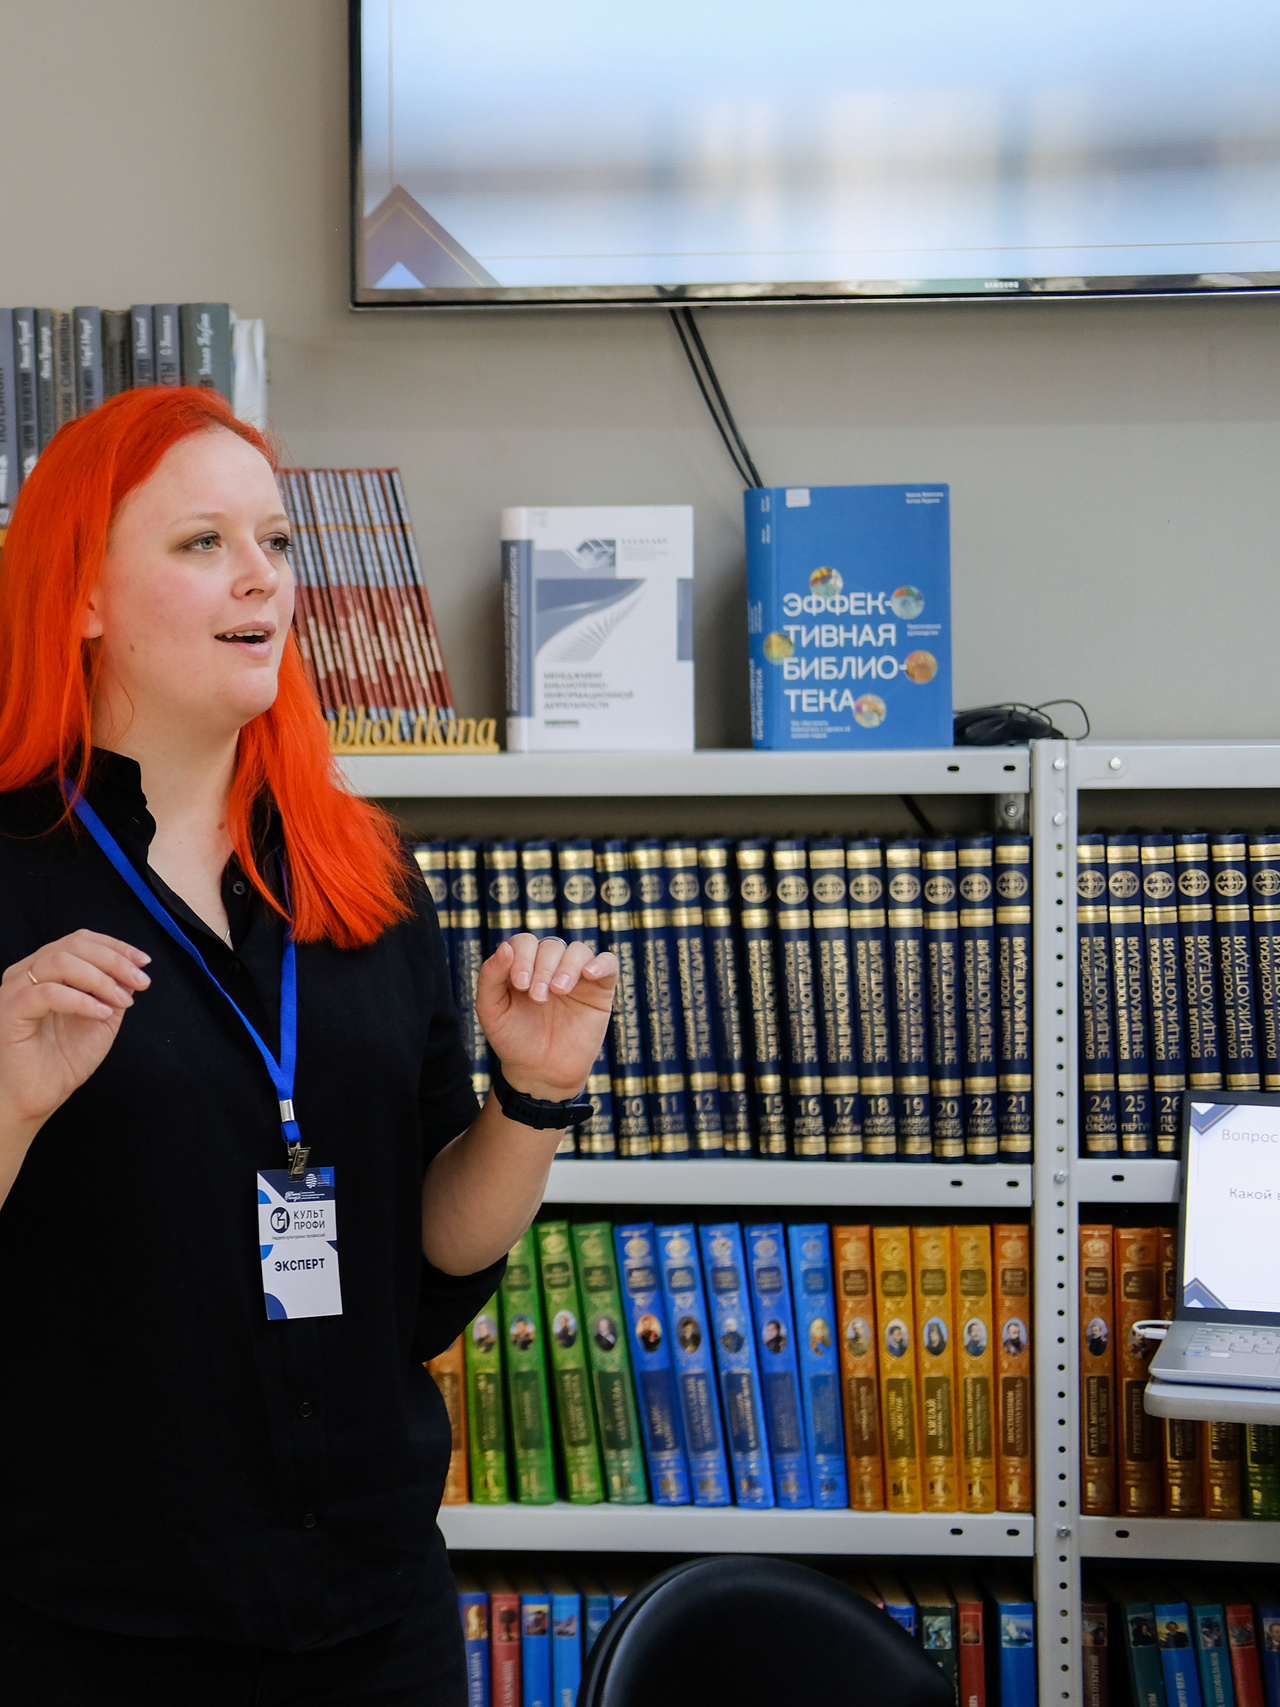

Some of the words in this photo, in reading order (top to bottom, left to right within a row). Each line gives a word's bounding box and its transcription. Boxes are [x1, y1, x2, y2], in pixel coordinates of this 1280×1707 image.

[783, 592, 892, 617] ЭФФЕК-
[783, 623, 896, 648] ТИВНАЯ
[783, 655, 907, 680] БИБЛИО-
[784, 688, 855, 713] ТЕКА
[643, 940, 658, 1010] РОССИЙСКАЯ
[677, 938, 691, 1009] РОССИЙСКАЯ
[748, 940, 762, 1010] РОССИЙСКАЯ
[785, 941, 798, 1012] РОССИЙСКАЯ
[820, 940, 834, 1011] РОССИЙСКАЯ
[856, 940, 870, 1011] РОССИЙСКАЯ
[894, 939, 907, 1011] РОССИЙСКАЯ
[929, 942, 940, 1013] РОССИЙСКАЯ
[963, 939, 976, 1010] РОССИЙСКАЯ
[1000, 936, 1011, 1008] РОССИЙСКАЯ
[1080, 936, 1093, 1007] РОССИЙСКАЯ
[1113, 936, 1128, 1007] РОССИЙСКАЯ
[1149, 938, 1164, 1008] РОССИЙСКАЯ
[1183, 935, 1199, 1006] РОССИЙСКАЯ
[1220, 936, 1235, 1006] РОССИЙСКАЯ
[1256, 936, 1273, 1006] РОССИЙСКАЯ
[619, 941, 642, 1064] ЭНЦИКЛОПЕДИЯ
[655, 939, 675, 1060] ЭНЦИКЛОПЕДИЯ
[690, 937, 711, 1059] ЭНЦИКЛОПЕДИЯ
[796, 940, 818, 1063] ЭНЦИКЛОПЕДИЯ
[832, 939, 853, 1063] ЭНЦИКЛОПЕДИЯ
[868, 940, 890, 1063] ЭНЦИКЛОПЕДИЯ
[906, 939, 925, 1062] ЭНЦИКЛОПЕДИЯ
[940, 941, 958, 1065] ЭНЦИКЛОПЕДИЯ
[976, 939, 994, 1063] ЭНЦИКЛОПЕДИЯ
[1012, 936, 1029, 1060] ЭНЦИКЛОПЕДИЯ
[1093, 935, 1112, 1060] ЭНЦИКЛОПЕДИЯ
[1126, 936, 1145, 1060] ЭНЦИКЛОПЕДИЯ
[1161, 937, 1181, 1060] ЭНЦИКЛОПЕДИЯ
[1196, 935, 1217, 1058] ЭНЦИКЛОПЕДИЯ
[1233, 935, 1255, 1059] ЭНЦИКЛОПЕДИЯ
[648, 1012, 661, 1062] БОЛЬШАЯ
[681, 1011, 695, 1060] БОЛЬШАЯ
[753, 1012, 768, 1062] БОЛЬШАЯ
[789, 1013, 802, 1064] БОЛЬШАЯ
[825, 1012, 837, 1063] БОЛЬШАЯ
[860, 1013, 874, 1064] БОЛЬШАЯ
[897, 1013, 909, 1064] БОЛЬШАЯ
[930, 1014, 942, 1065] БОЛЬШАЯ
[965, 1012, 978, 1063] БОЛЬШАЯ
[1001, 1009, 1012, 1060] БОЛЬШАЯ
[1083, 1009, 1096, 1060] БОЛЬШАЯ
[1117, 1009, 1130, 1060] БОЛЬШАЯ
[1152, 1010, 1166, 1060] БОЛЬШАЯ
[1187, 1007, 1201, 1059] БОЛЬШАЯ
[1223, 1008, 1238, 1059] БОЛЬШАЯ
[1259, 1008, 1278, 1059] БОЛЬШАЯ
[623, 1097, 645, 1117] 10
[658, 1095, 678, 1114] 11
[693, 1093, 714, 1112] 12
[798, 1096, 821, 1116] 16
[833, 1095, 856, 1116] 17
[869, 1096, 889, 1116] 18
[903, 1096, 924, 1116] 19
[937, 1099, 959, 1118] 20
[971, 1096, 993, 1116] 22
[1006, 1094, 1027, 1113] 21
[1089, 1094, 1112, 1113] 24
[1124, 1094, 1146, 1113] 25
[294, 1209, 324, 1219] КУЛЬТ
[1228, 1187, 1273, 1201] Какой
[294, 1220, 325, 1230] ПРОФИ
[275, 1258, 325, 1272] ЭКСПЕРТ
[927, 1398, 937, 1436] КИТАЙ
